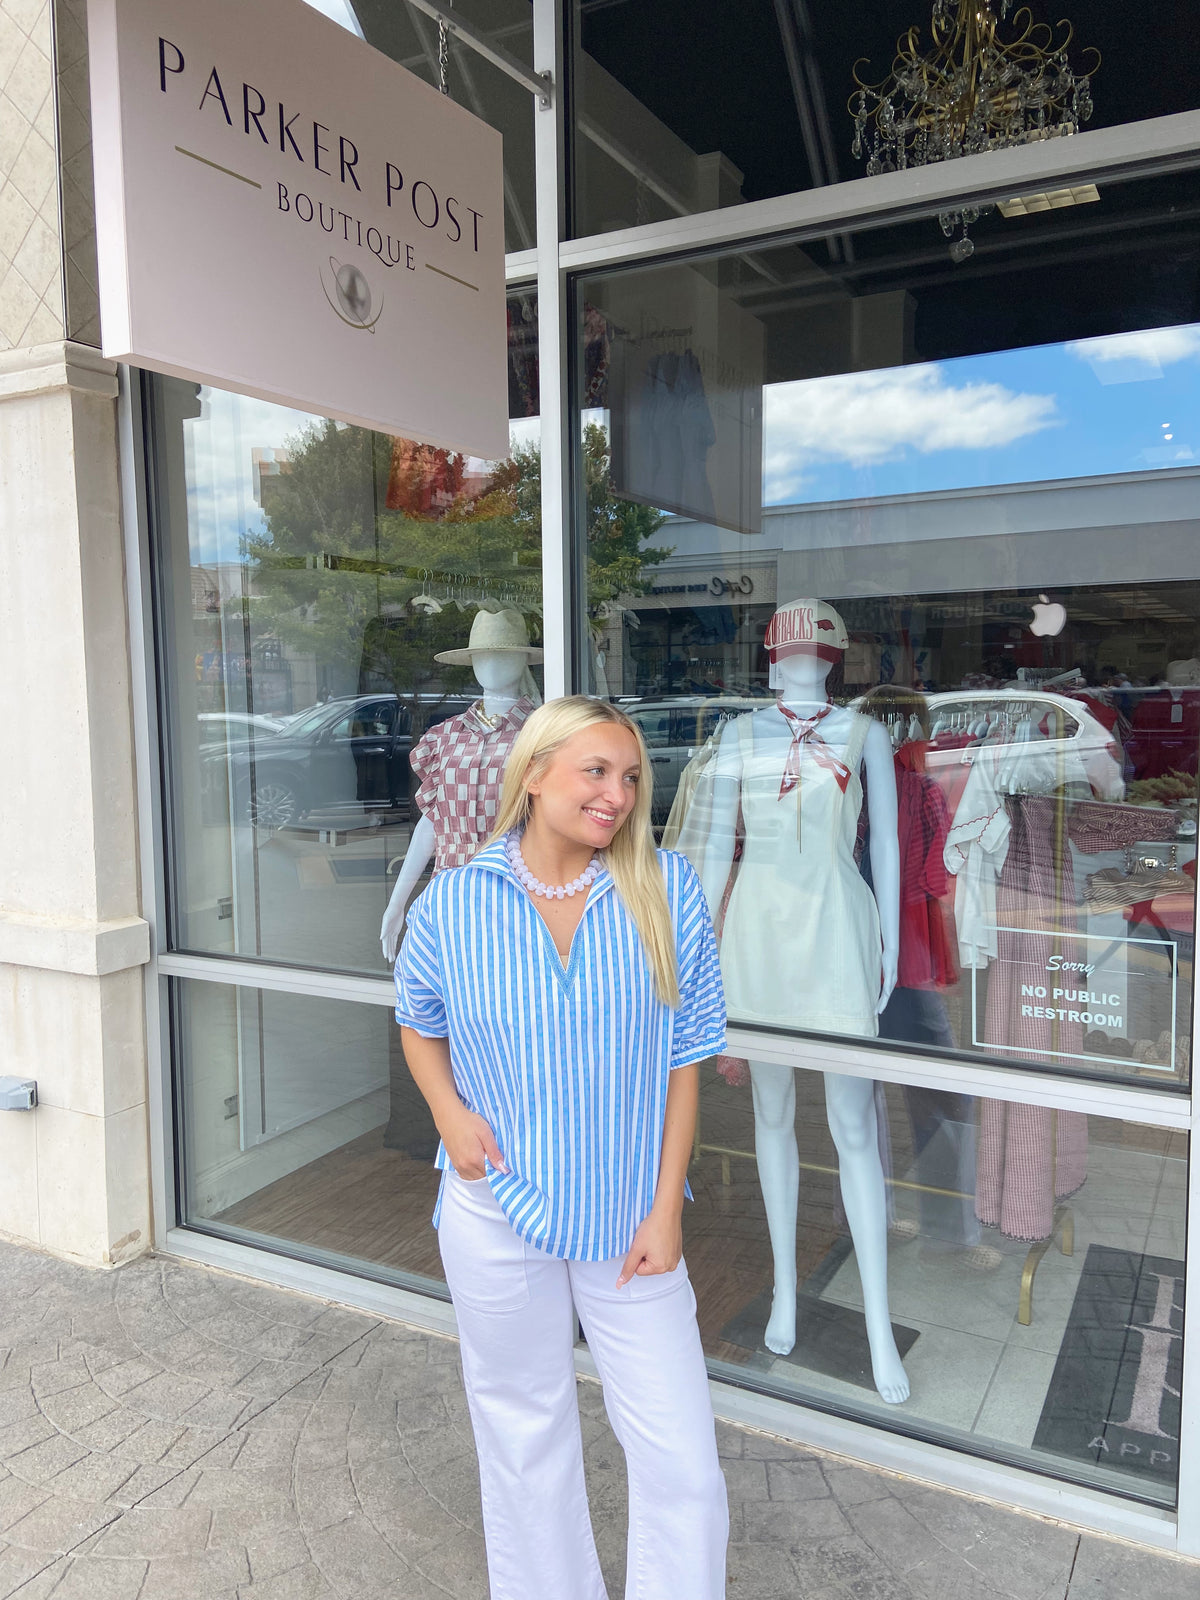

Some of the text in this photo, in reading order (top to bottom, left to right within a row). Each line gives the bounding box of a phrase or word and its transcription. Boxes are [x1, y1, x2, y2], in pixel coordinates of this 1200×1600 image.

[157, 36, 485, 253] PARKER POST
[277, 182, 417, 273] BOUTIQUE
[1045, 955, 1096, 977] Sorry
[1021, 984, 1121, 1007] NO PUBLIC
[1021, 1004, 1123, 1028] RESTROOM
[1087, 1435, 1172, 1465] APP
